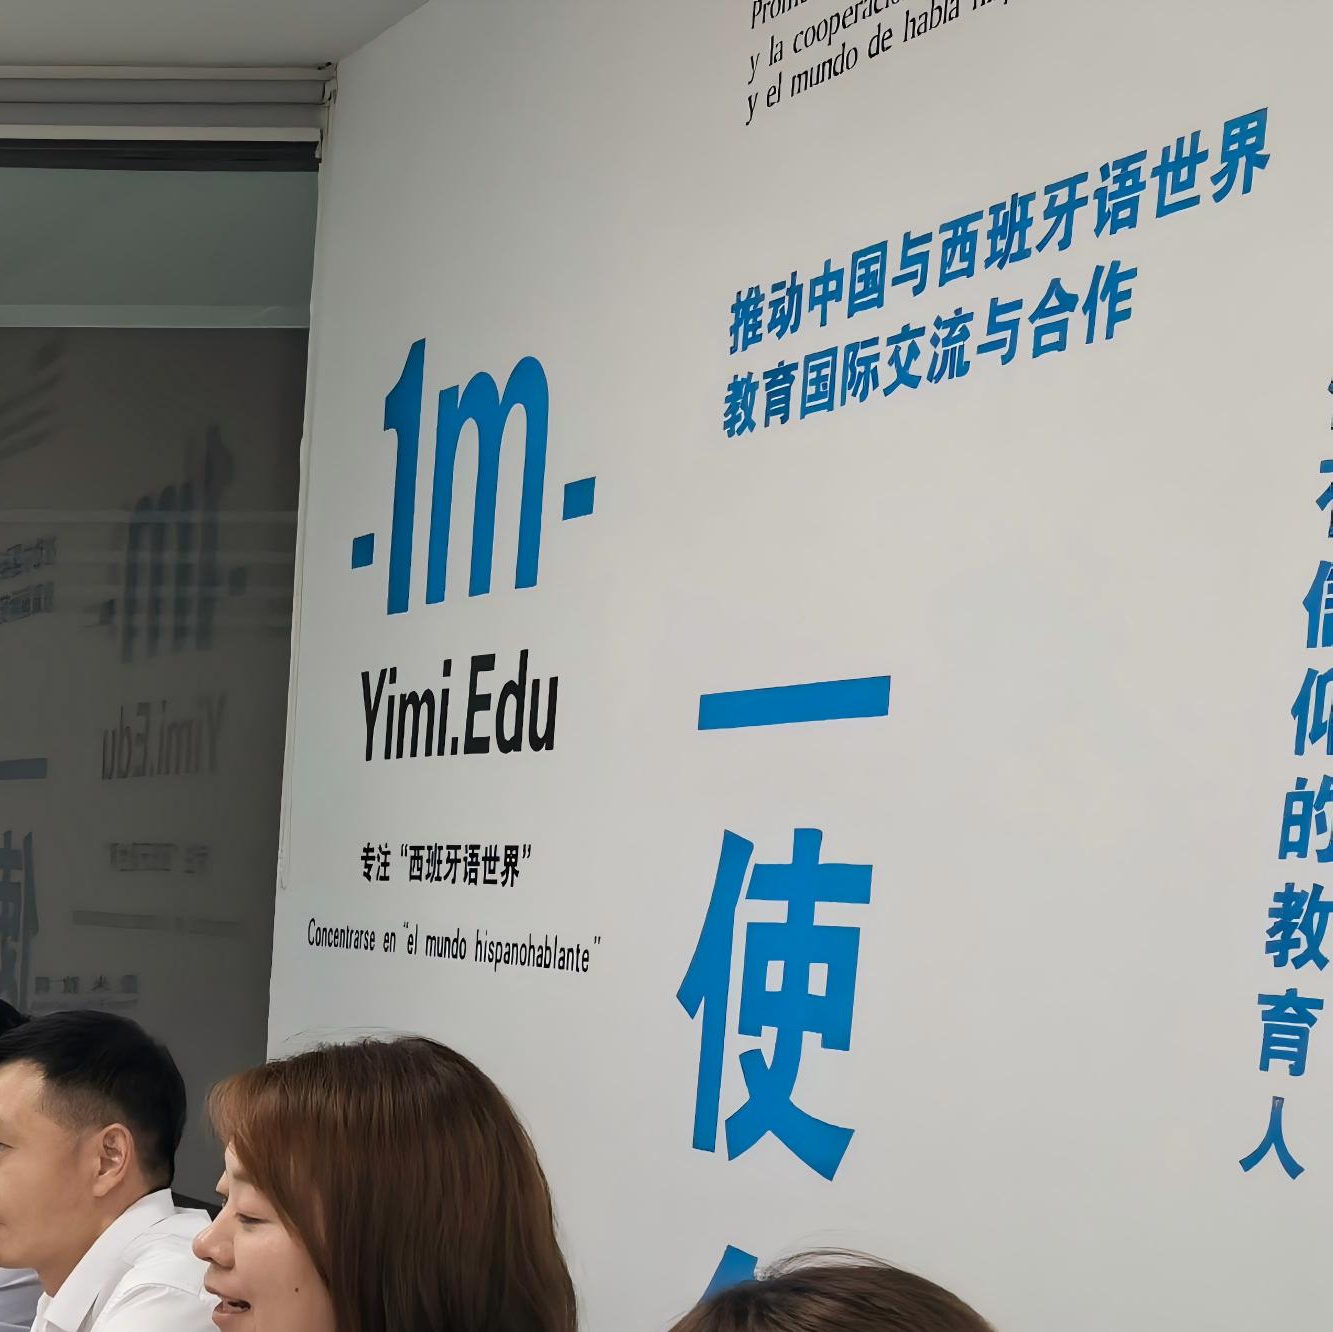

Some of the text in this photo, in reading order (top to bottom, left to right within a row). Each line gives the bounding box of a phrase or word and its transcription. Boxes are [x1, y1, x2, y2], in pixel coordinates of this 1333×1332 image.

[746, 0, 960, 126] y el mundo de habla
[748, 0, 900, 85] y la cooperac
[729, 108, 1271, 355] 推动中国与西班牙语世界
[723, 260, 1138, 438] 教育国际交流与合作
[360, 648, 559, 762] Yimi.Edu
[307, 917, 375, 952] Concentrarse
[383, 929, 396, 953] en
[425, 927, 467, 960] mundo
